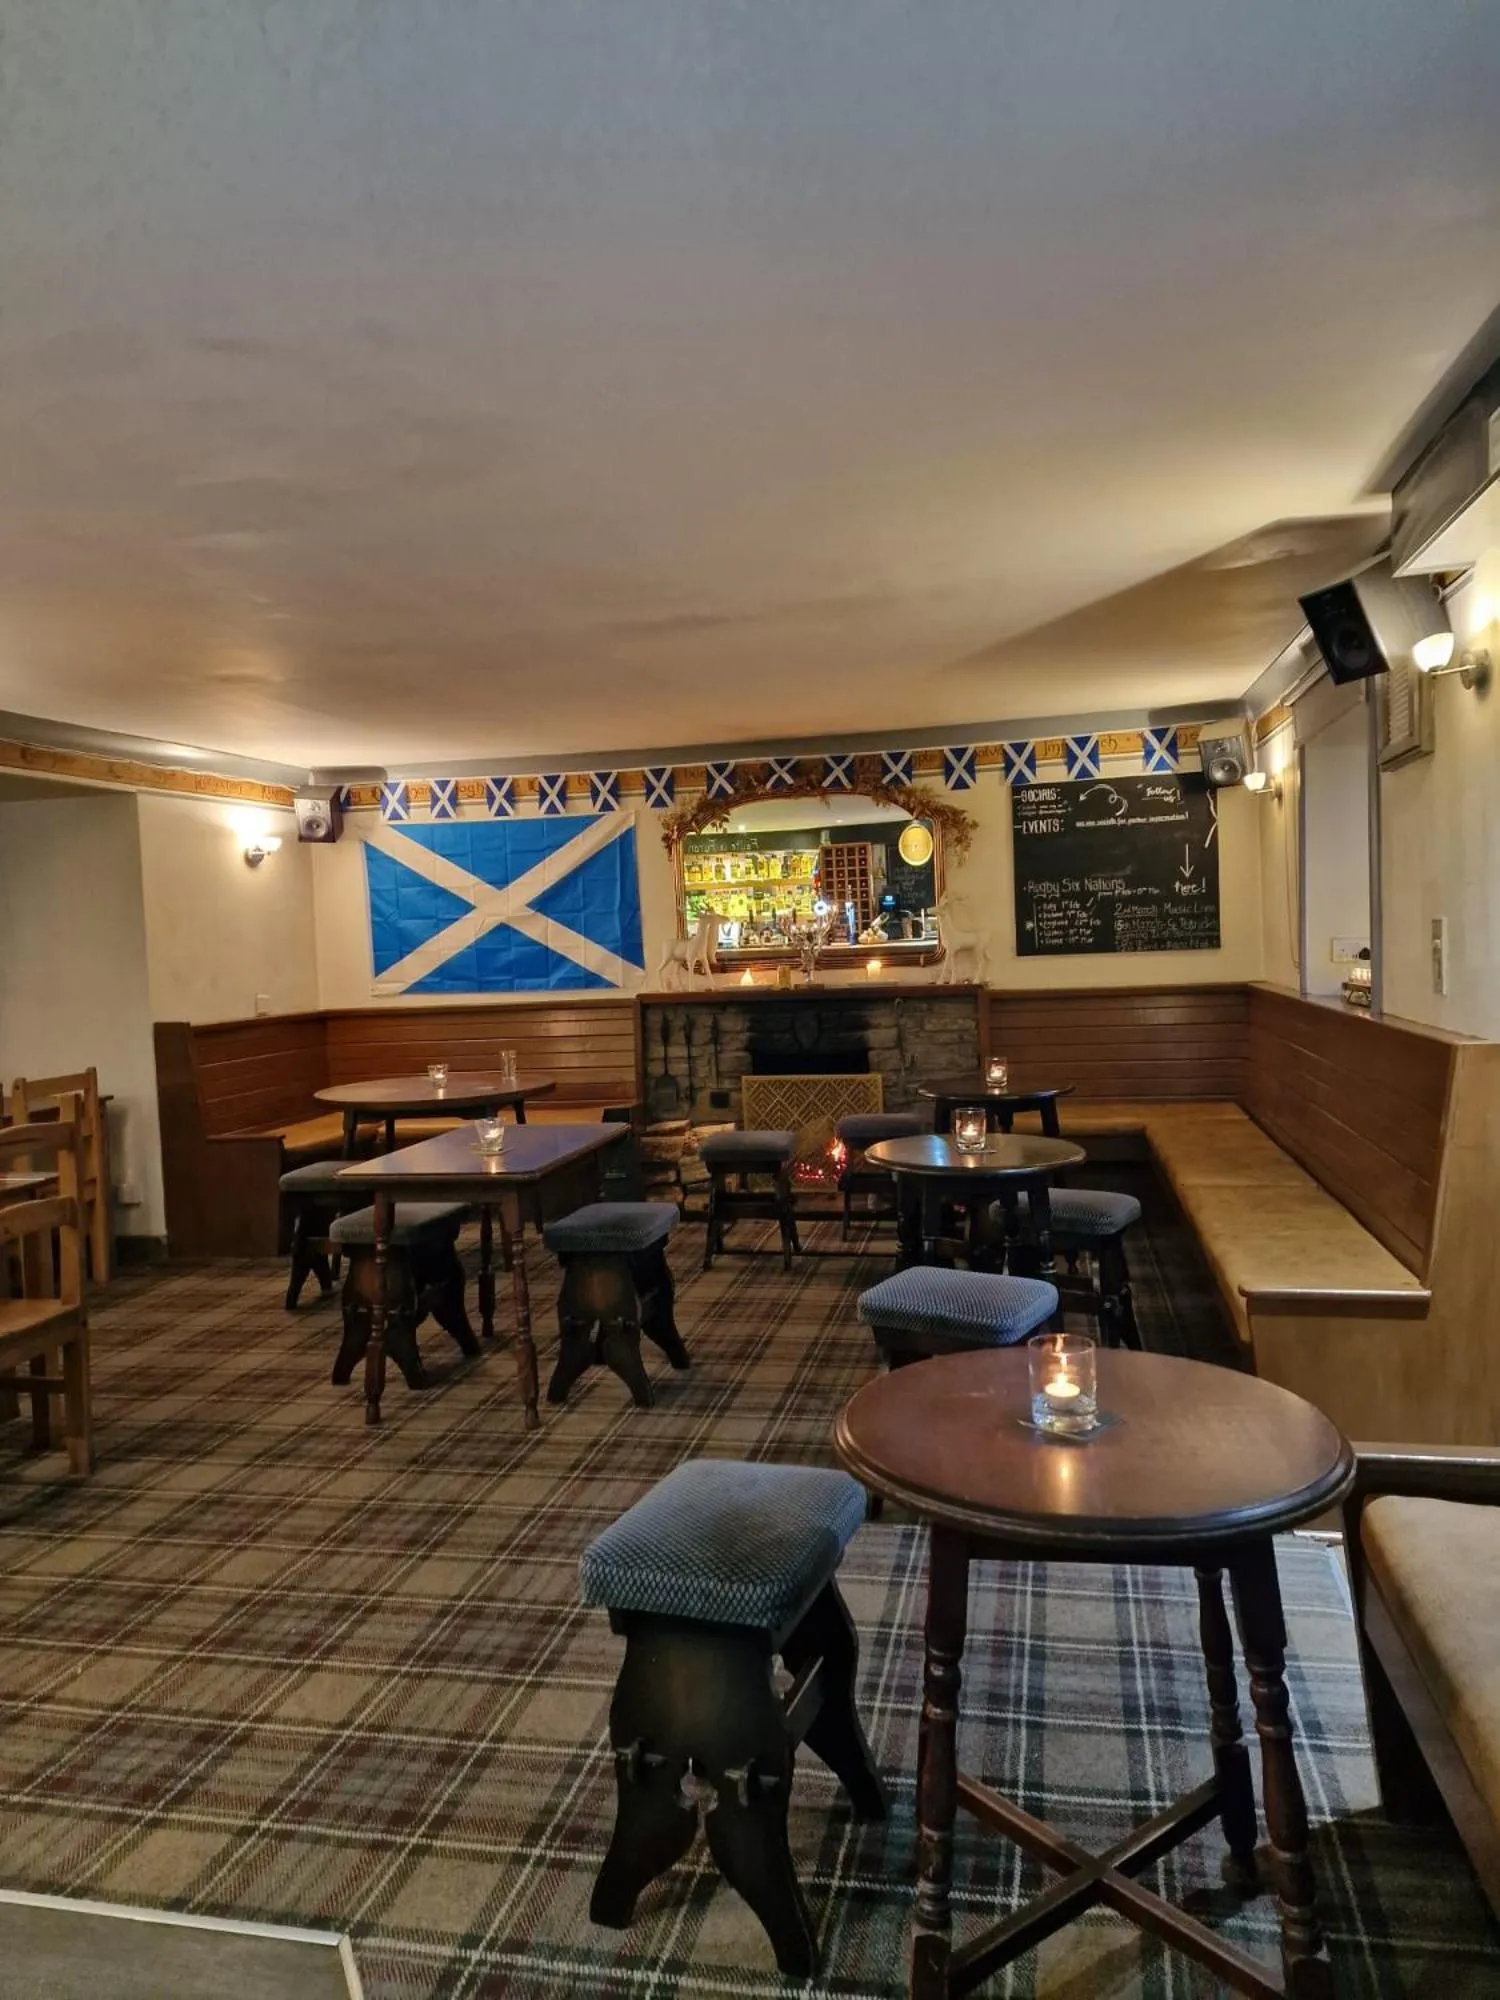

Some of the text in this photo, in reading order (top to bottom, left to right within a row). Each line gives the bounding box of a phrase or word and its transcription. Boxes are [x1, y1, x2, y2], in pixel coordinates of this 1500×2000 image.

[1145, 786, 1175, 797] Follow
[1022, 818, 1065, 834] EVENTS:
[1027, 879, 1060, 899] Rugby
[1061, 876, 1081, 893] Six
[1084, 877, 1126, 892] Nations
